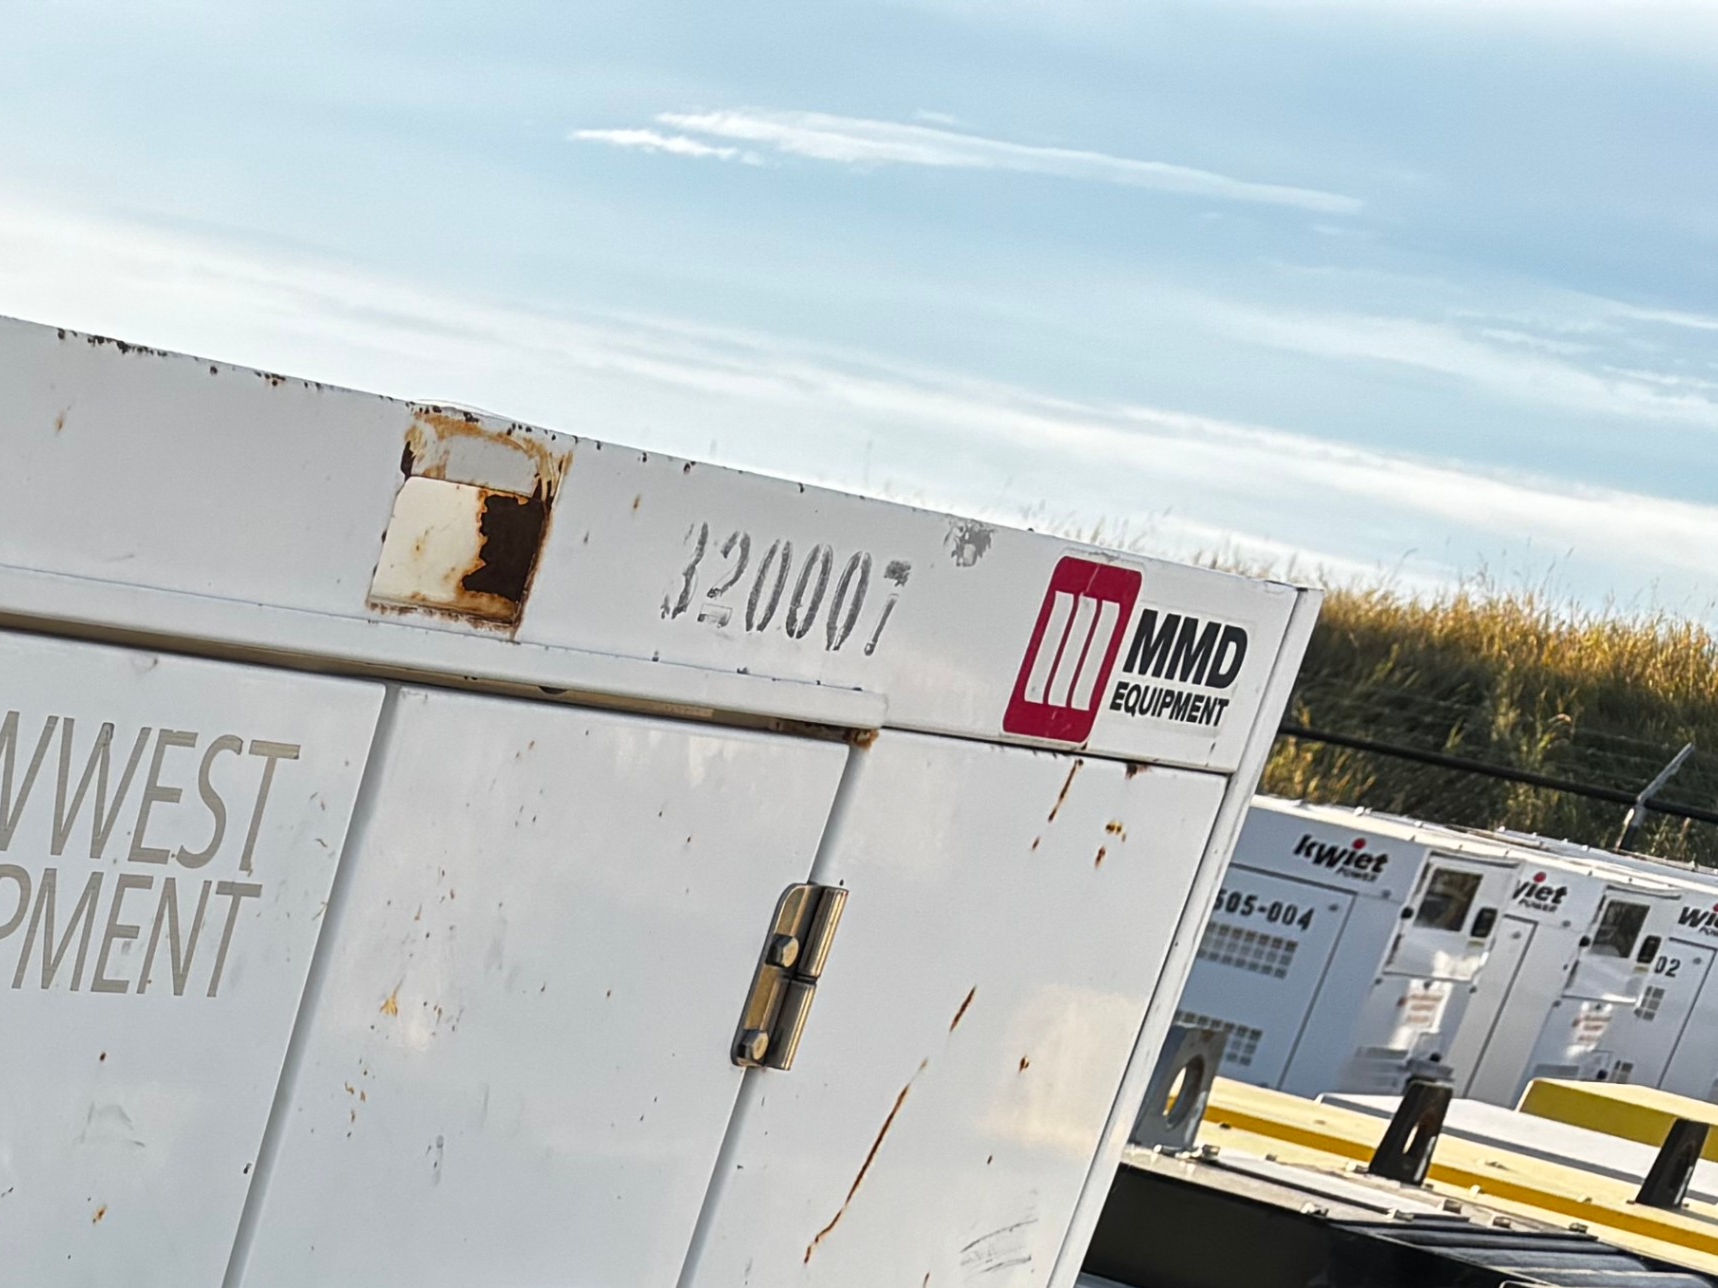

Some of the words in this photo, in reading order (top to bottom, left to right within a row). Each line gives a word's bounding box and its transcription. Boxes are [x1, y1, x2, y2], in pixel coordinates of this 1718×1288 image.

[660, 520, 913, 656] 320007
[1122, 608, 1248, 690] MMD
[1109, 680, 1230, 727] EQUIPMENT
